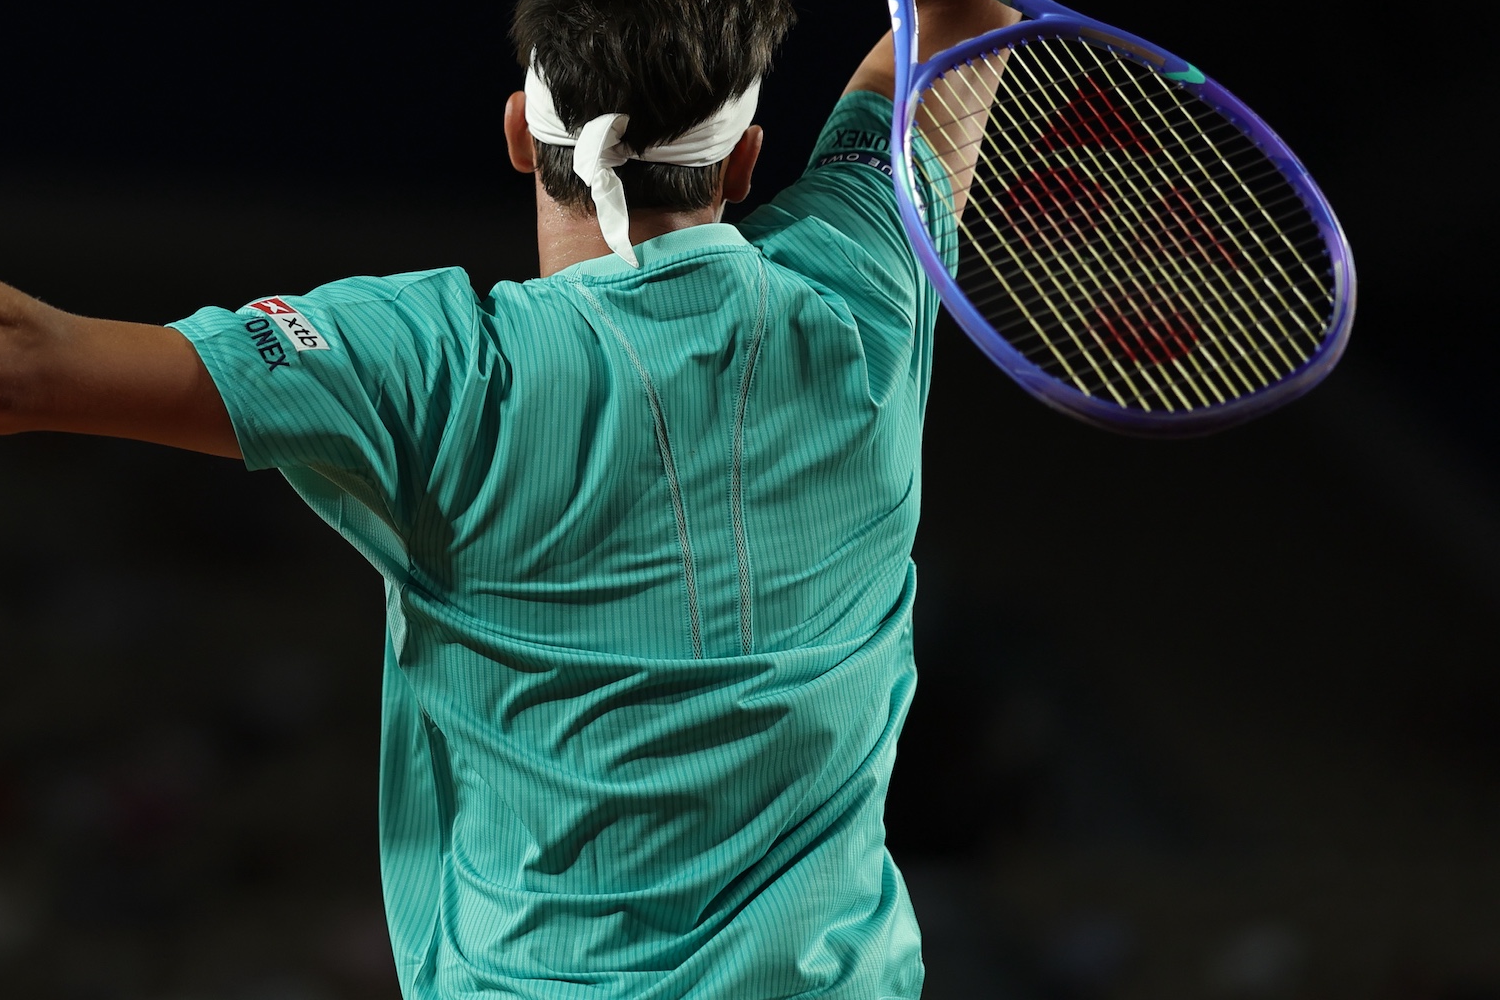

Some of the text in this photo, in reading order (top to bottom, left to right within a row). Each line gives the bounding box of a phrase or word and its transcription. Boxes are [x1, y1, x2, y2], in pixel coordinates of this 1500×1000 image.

[832, 129, 890, 151] ONEX
[820, 153, 893, 175] UE OWL
[244, 316, 290, 372] ONEX
[282, 317, 317, 348] xtb
